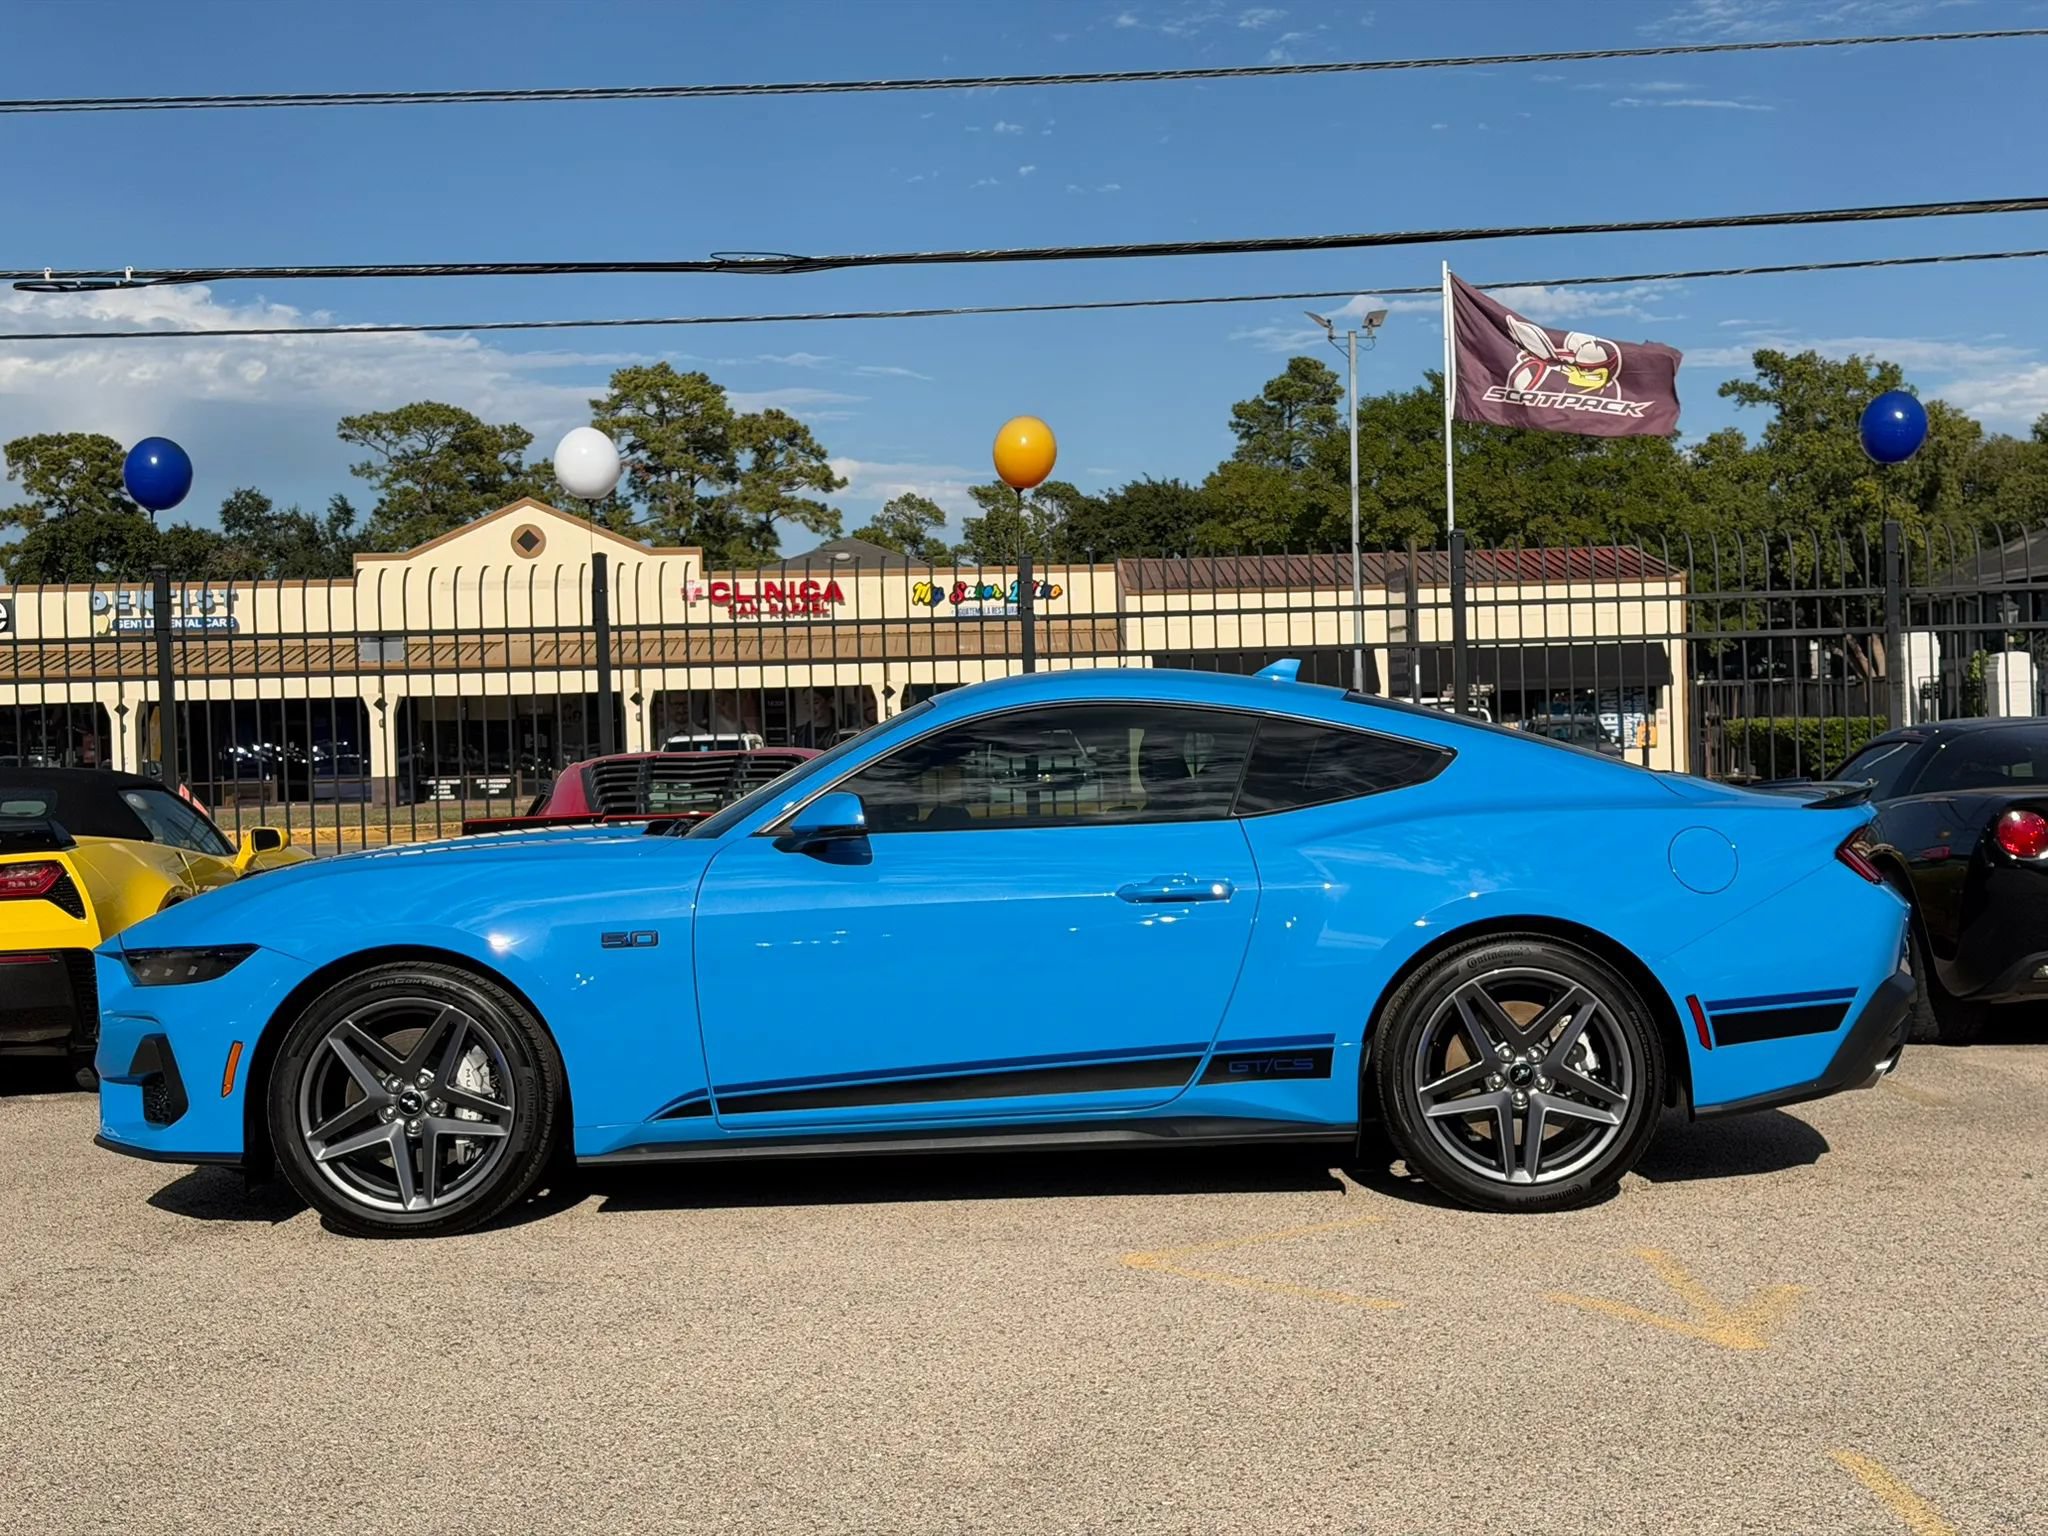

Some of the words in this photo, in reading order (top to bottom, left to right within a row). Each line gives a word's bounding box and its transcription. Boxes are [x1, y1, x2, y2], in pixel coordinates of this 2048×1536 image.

[91, 589, 236, 612] DENIST
[1007, 580, 1063, 603] Ltino
[165, 618, 202, 628] ENTAL
[1229, 1058, 1314, 1073] GT/CS
